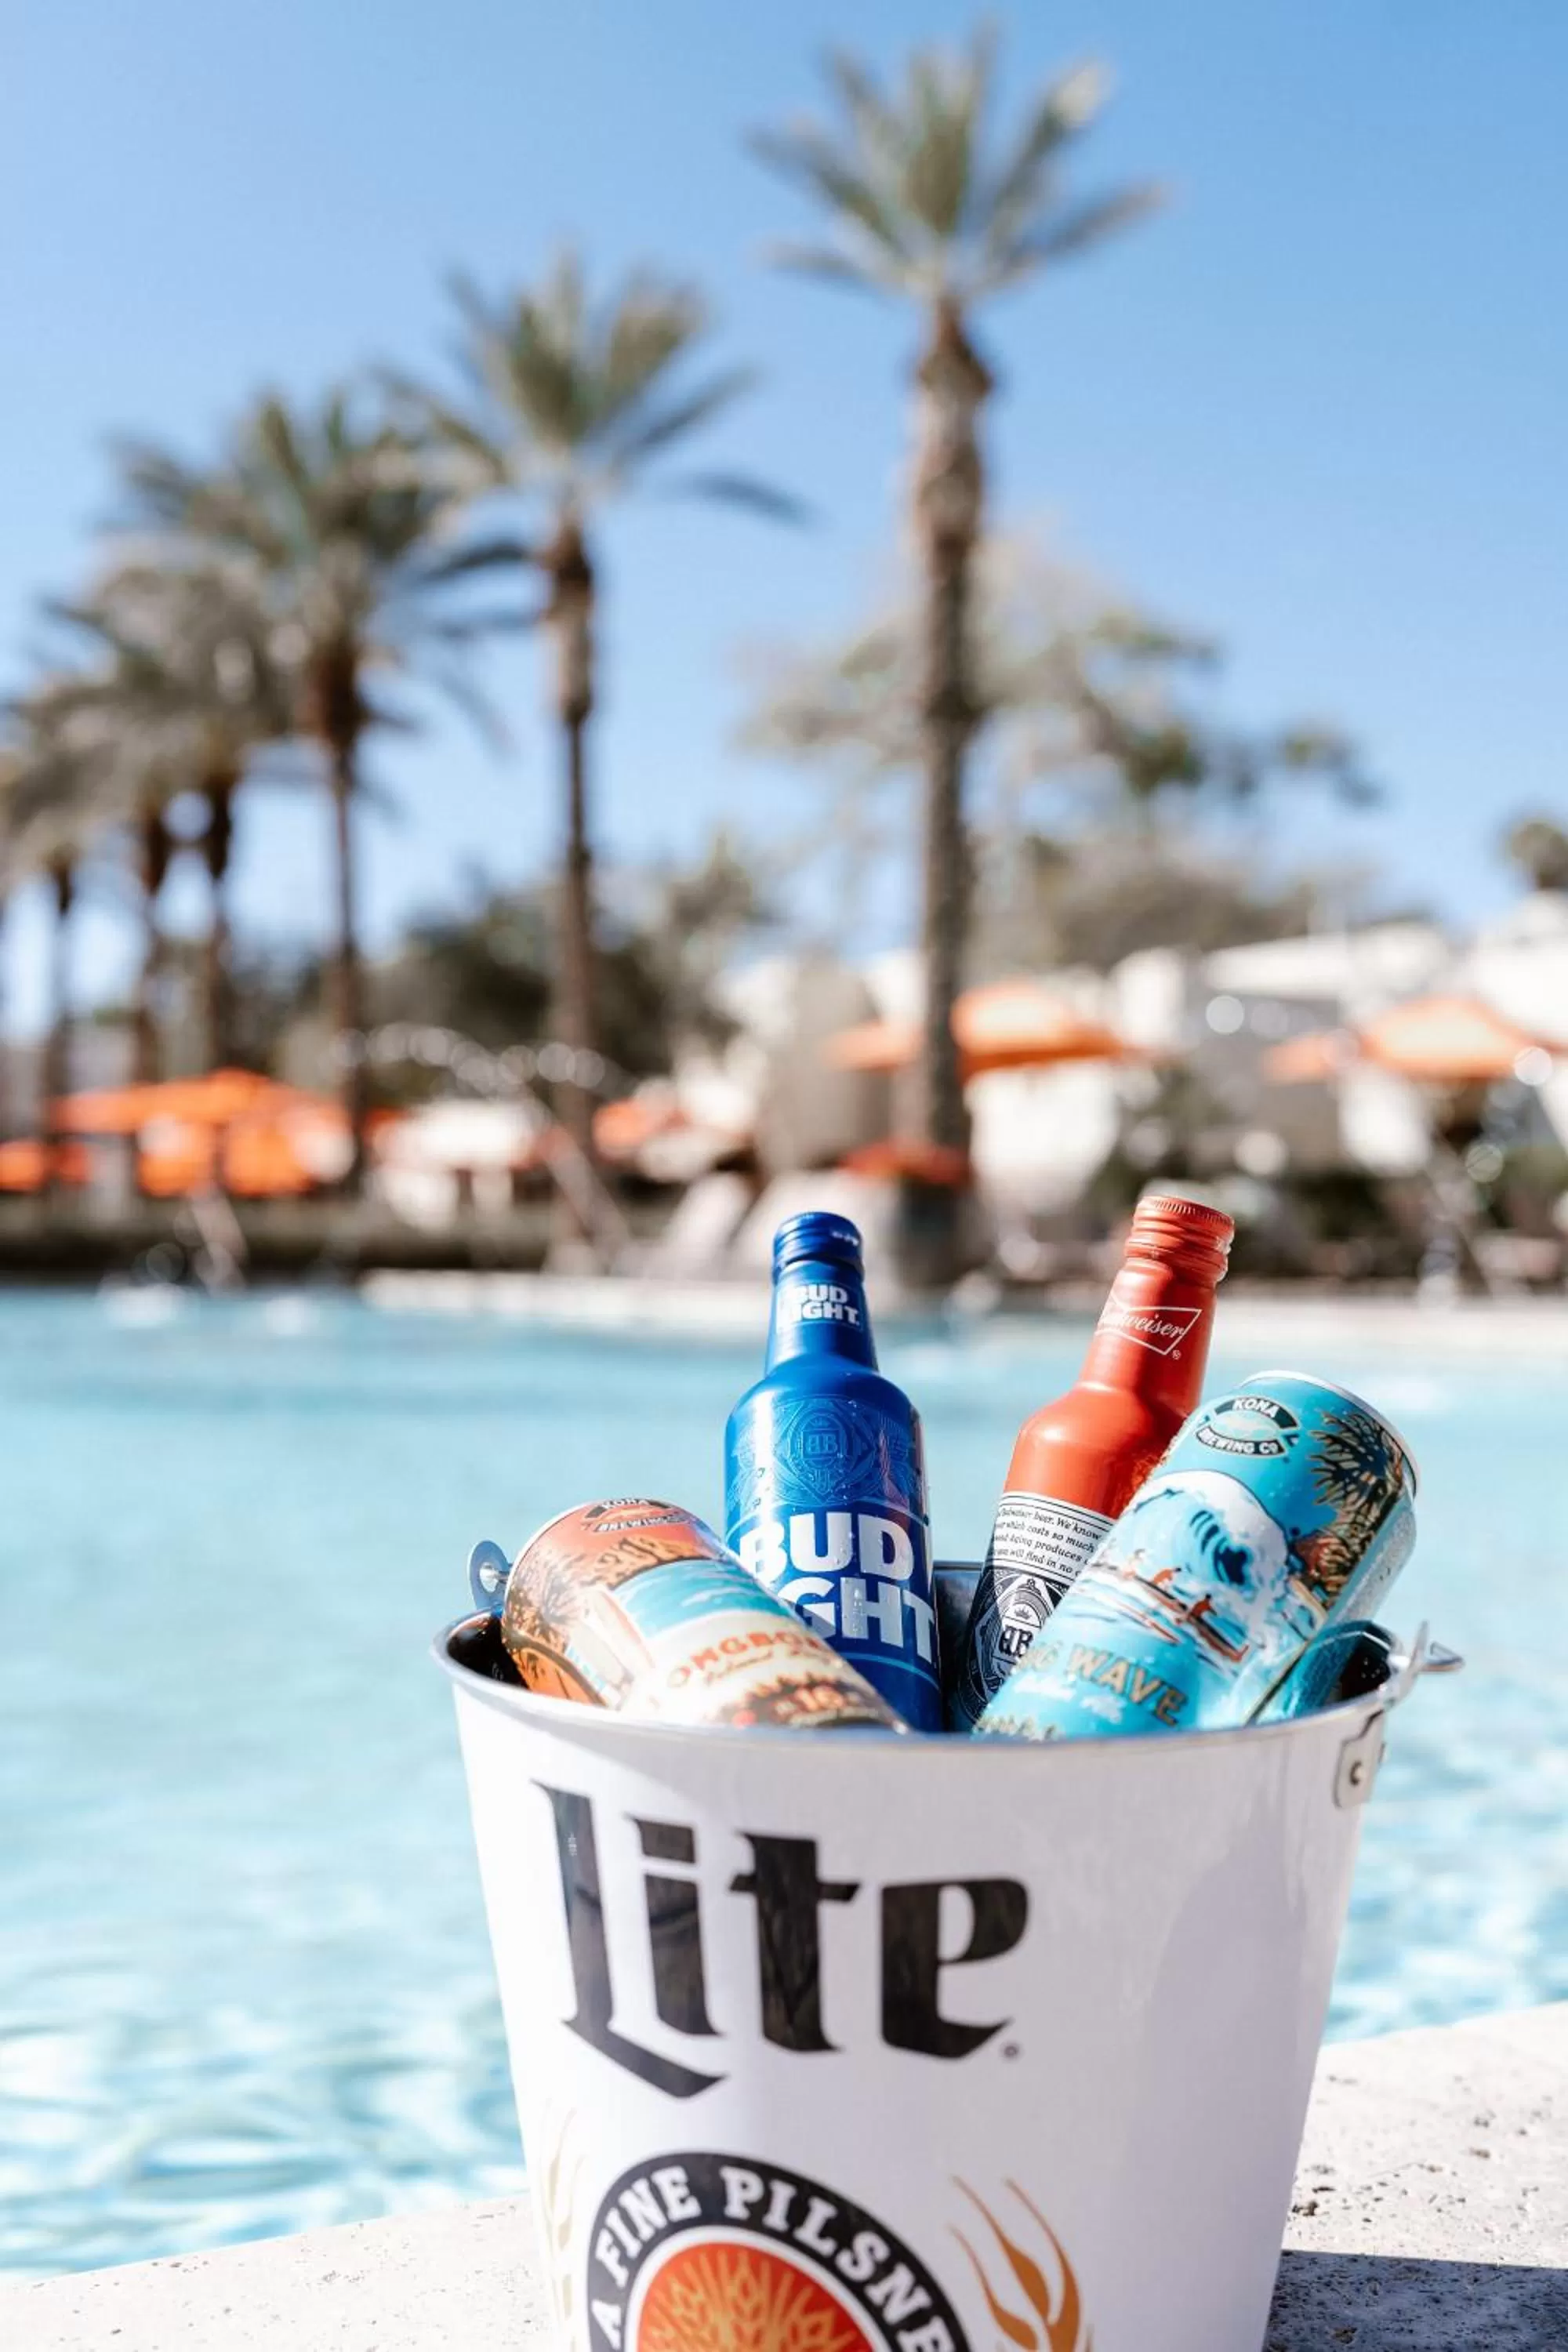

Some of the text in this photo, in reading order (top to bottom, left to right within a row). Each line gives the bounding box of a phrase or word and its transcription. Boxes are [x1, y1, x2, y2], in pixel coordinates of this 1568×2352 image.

[780, 1301, 859, 1326] IGHT
[1232, 1397, 1279, 1418] KONA
[1027, 1525, 1050, 1537] costs
[1051, 1532, 1064, 1541] so
[1066, 1537, 1094, 1553] much
[1056, 1517, 1071, 1529] We
[1073, 1521, 1102, 1540] know
[739, 1512, 914, 1590] BUD
[1026, 1550, 1044, 1564] find
[1047, 1557, 1057, 1567] in
[1059, 1563, 1073, 1573] no
[1034, 1541, 1083, 1562] produces
[777, 1576, 936, 1664] GHT
[1065, 1643, 1188, 1727] WAVE
[530, 1779, 1029, 2100] Lite
[590, 2165, 956, 2352] A FINE PILSNE
